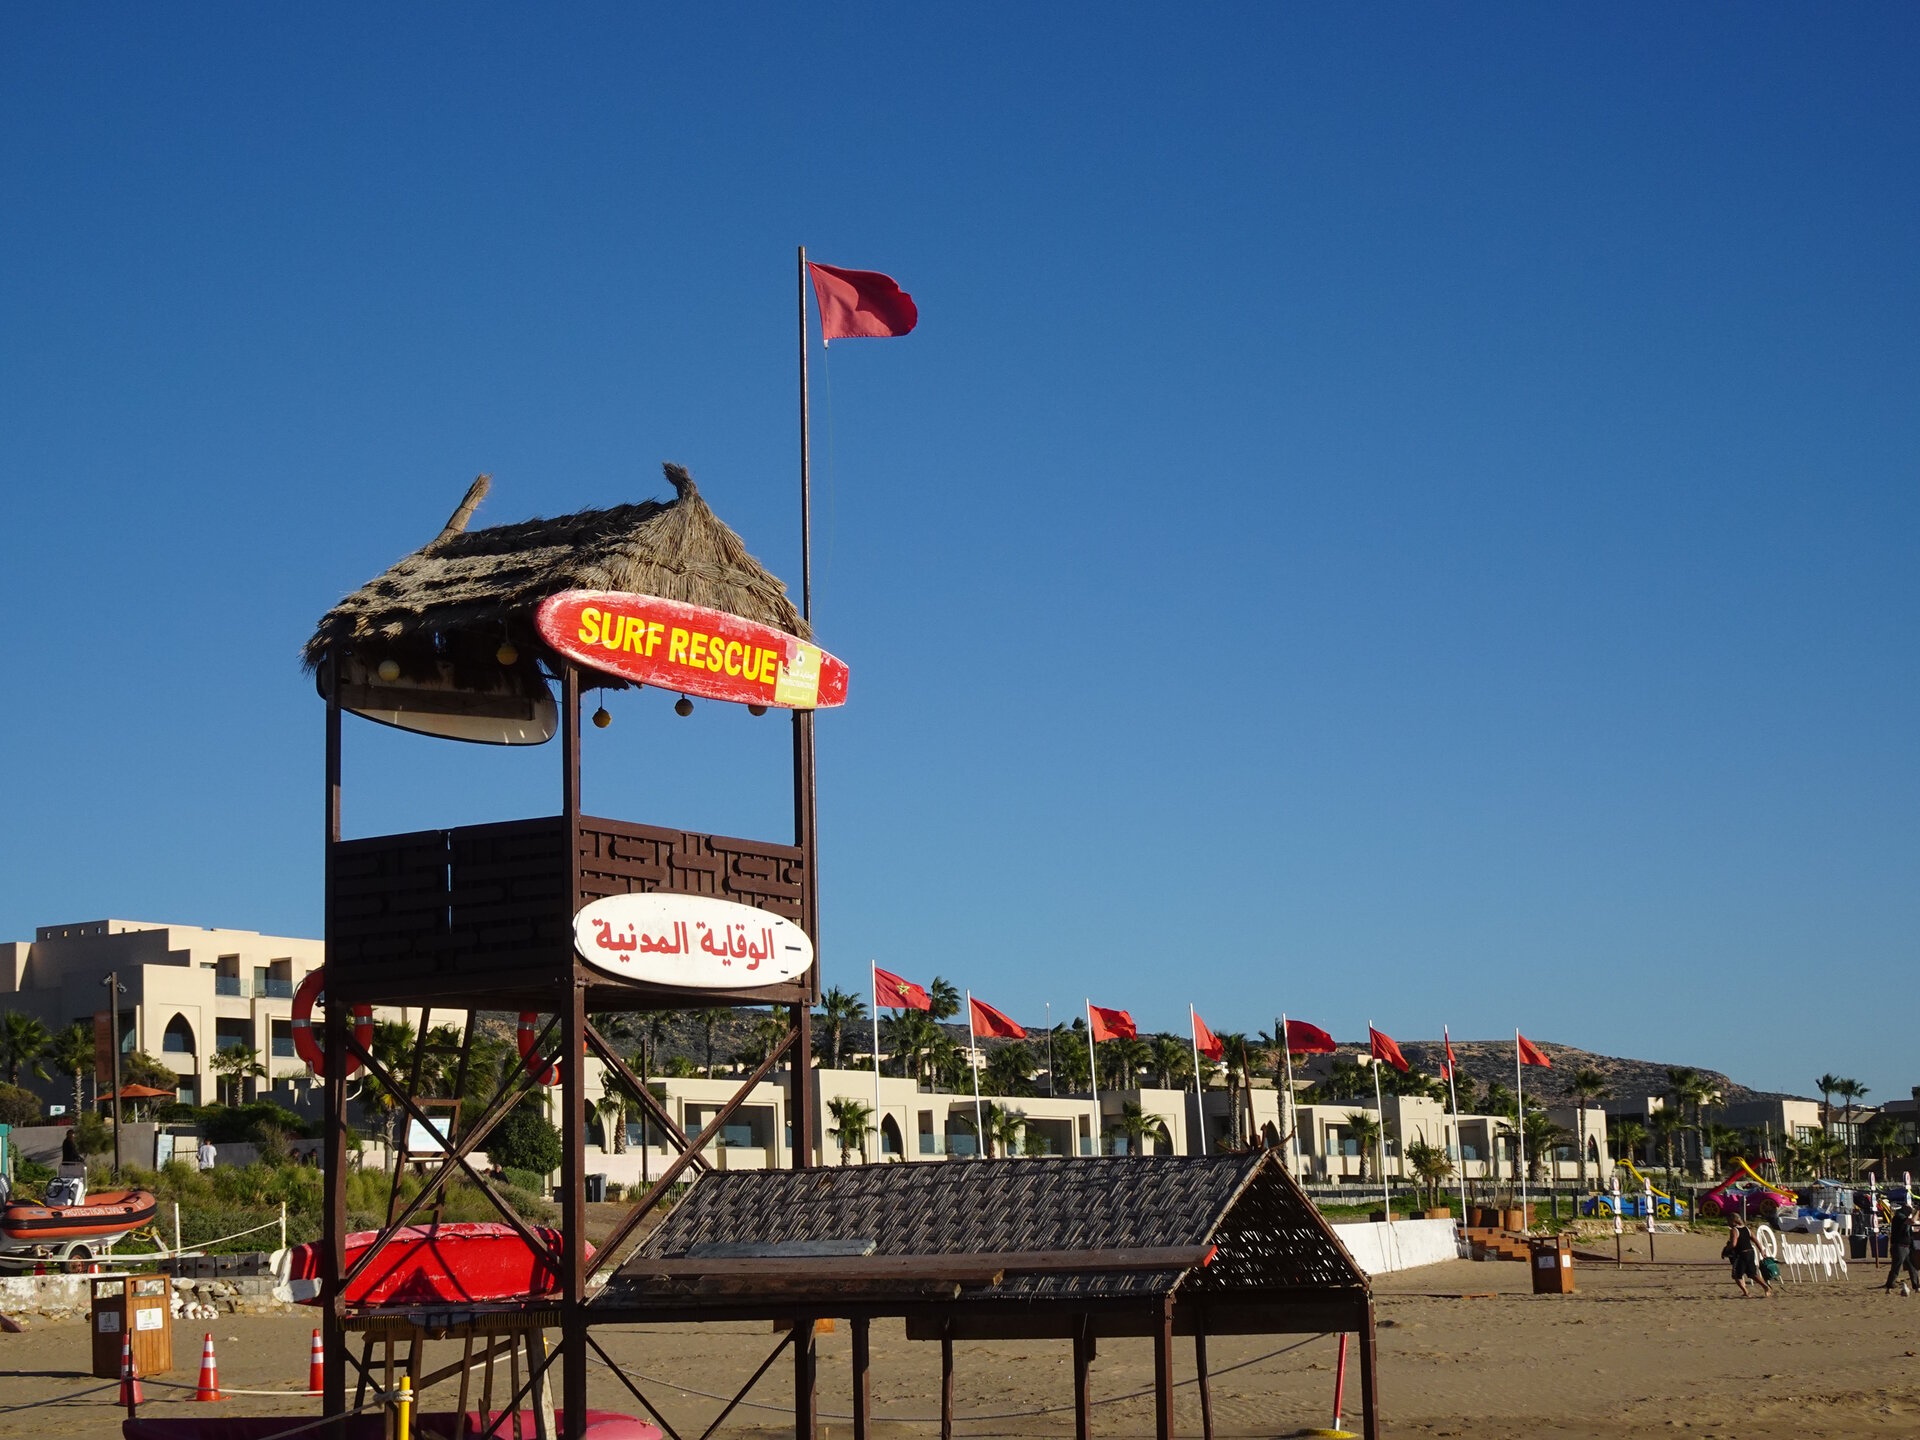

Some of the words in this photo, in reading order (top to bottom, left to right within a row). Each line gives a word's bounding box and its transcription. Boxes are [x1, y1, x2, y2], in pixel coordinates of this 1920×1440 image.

[578, 607, 664, 657] SURF
[668, 628, 778, 685] RESCUE
[592, 918, 689, 963] المدنية
[695, 921, 775, 970] الوقاية
[62, 1206, 104, 1217] PROTECTION
[104, 1205, 126, 1215] CIVILE
